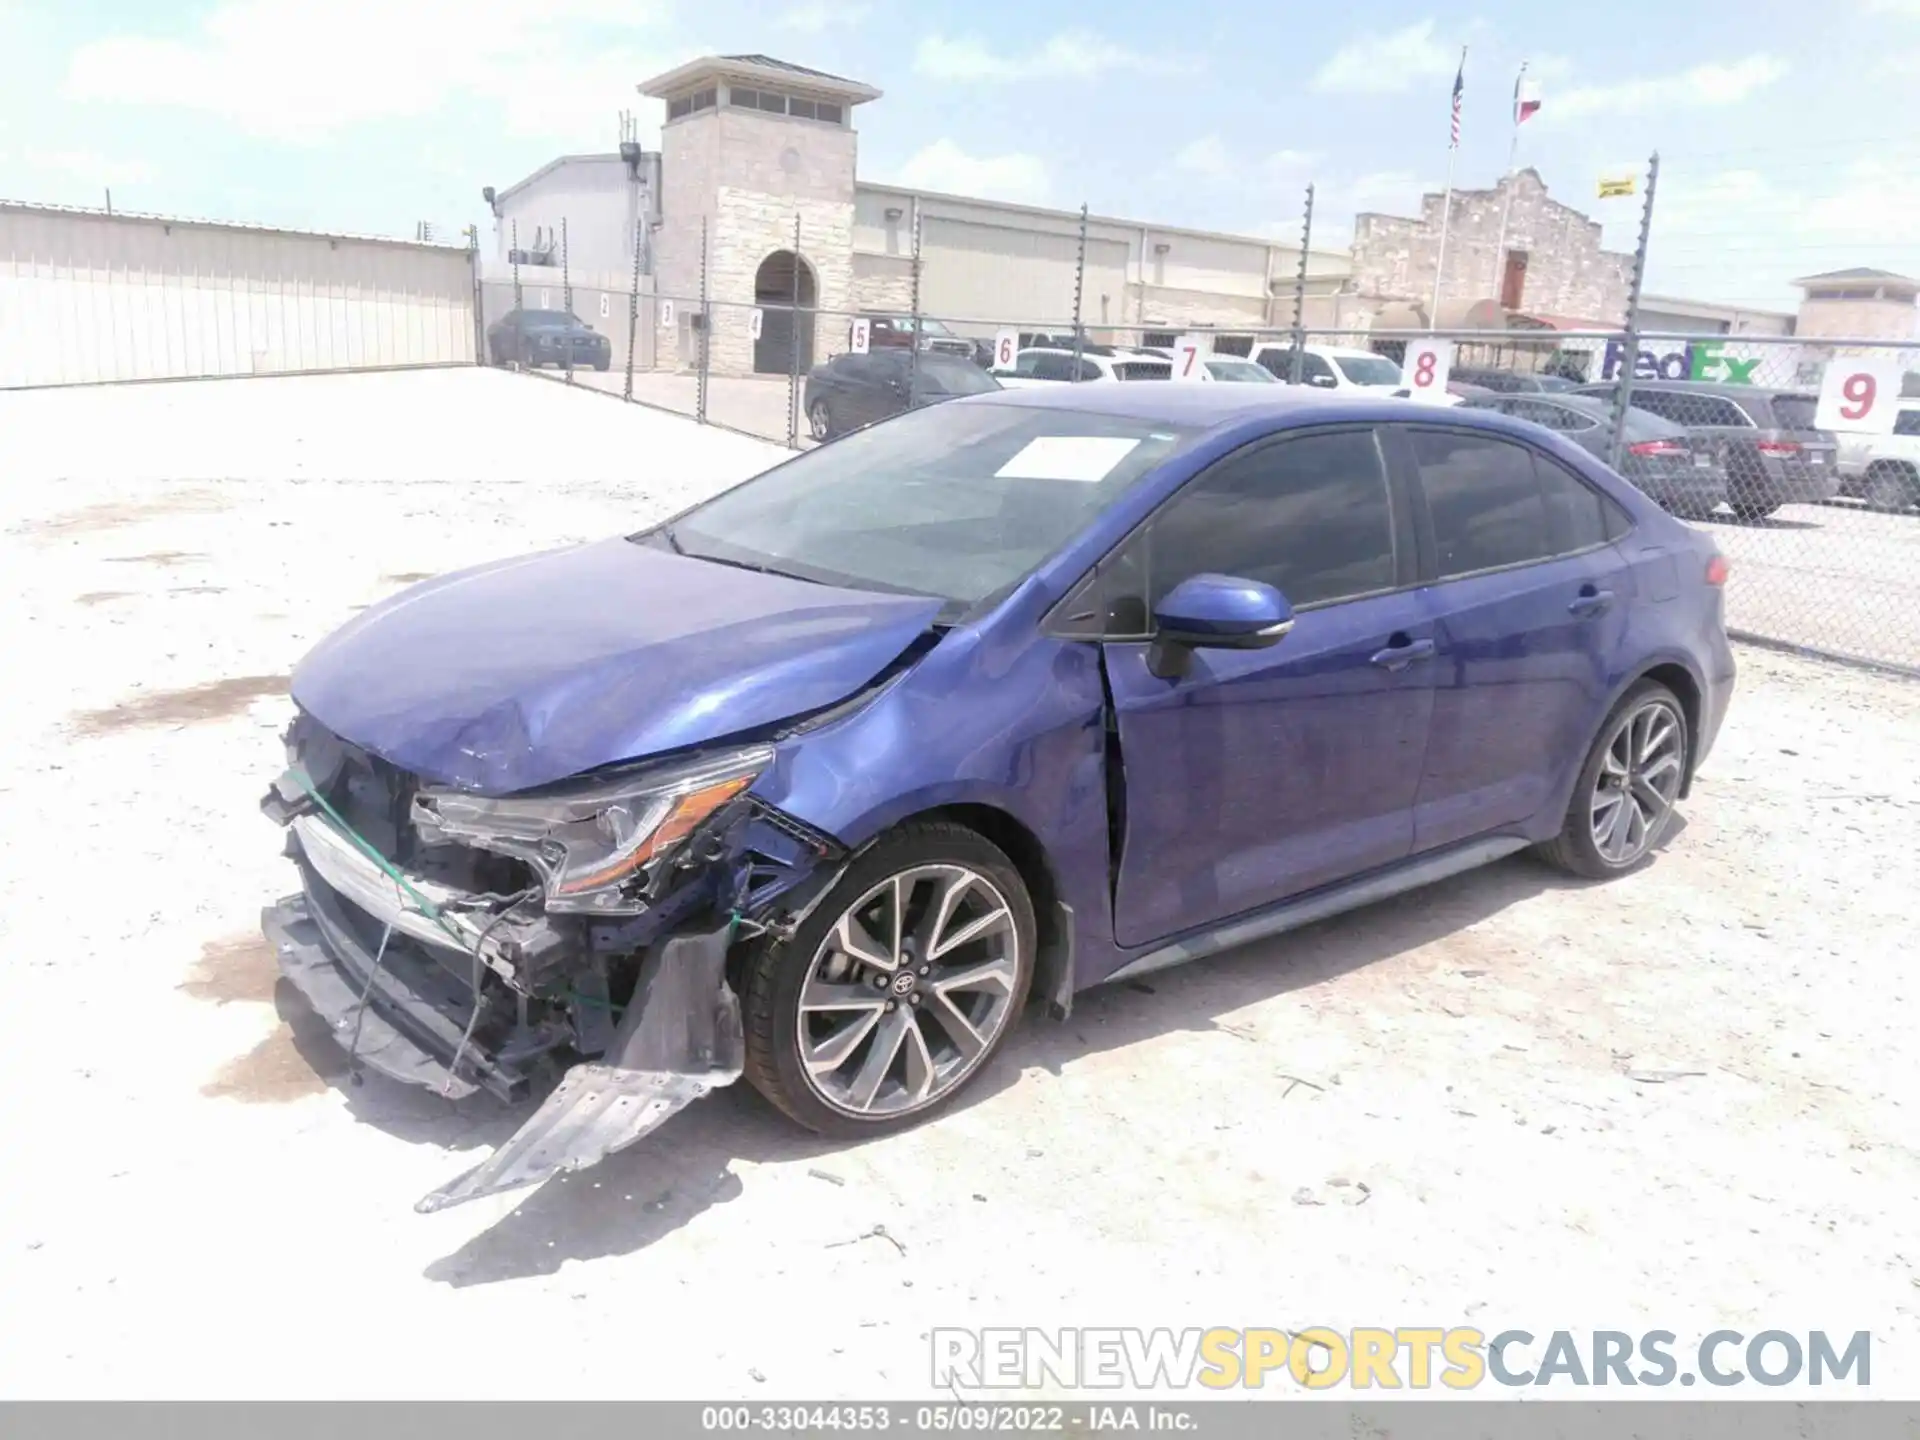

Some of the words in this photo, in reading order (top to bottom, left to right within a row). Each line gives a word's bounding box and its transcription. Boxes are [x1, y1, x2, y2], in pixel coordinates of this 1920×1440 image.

[856, 325, 866, 348] 5
[1000, 338, 1012, 364] 6
[1183, 347, 1197, 377] 7
[1414, 351, 1437, 387] 8
[1840, 372, 1877, 420] 9
